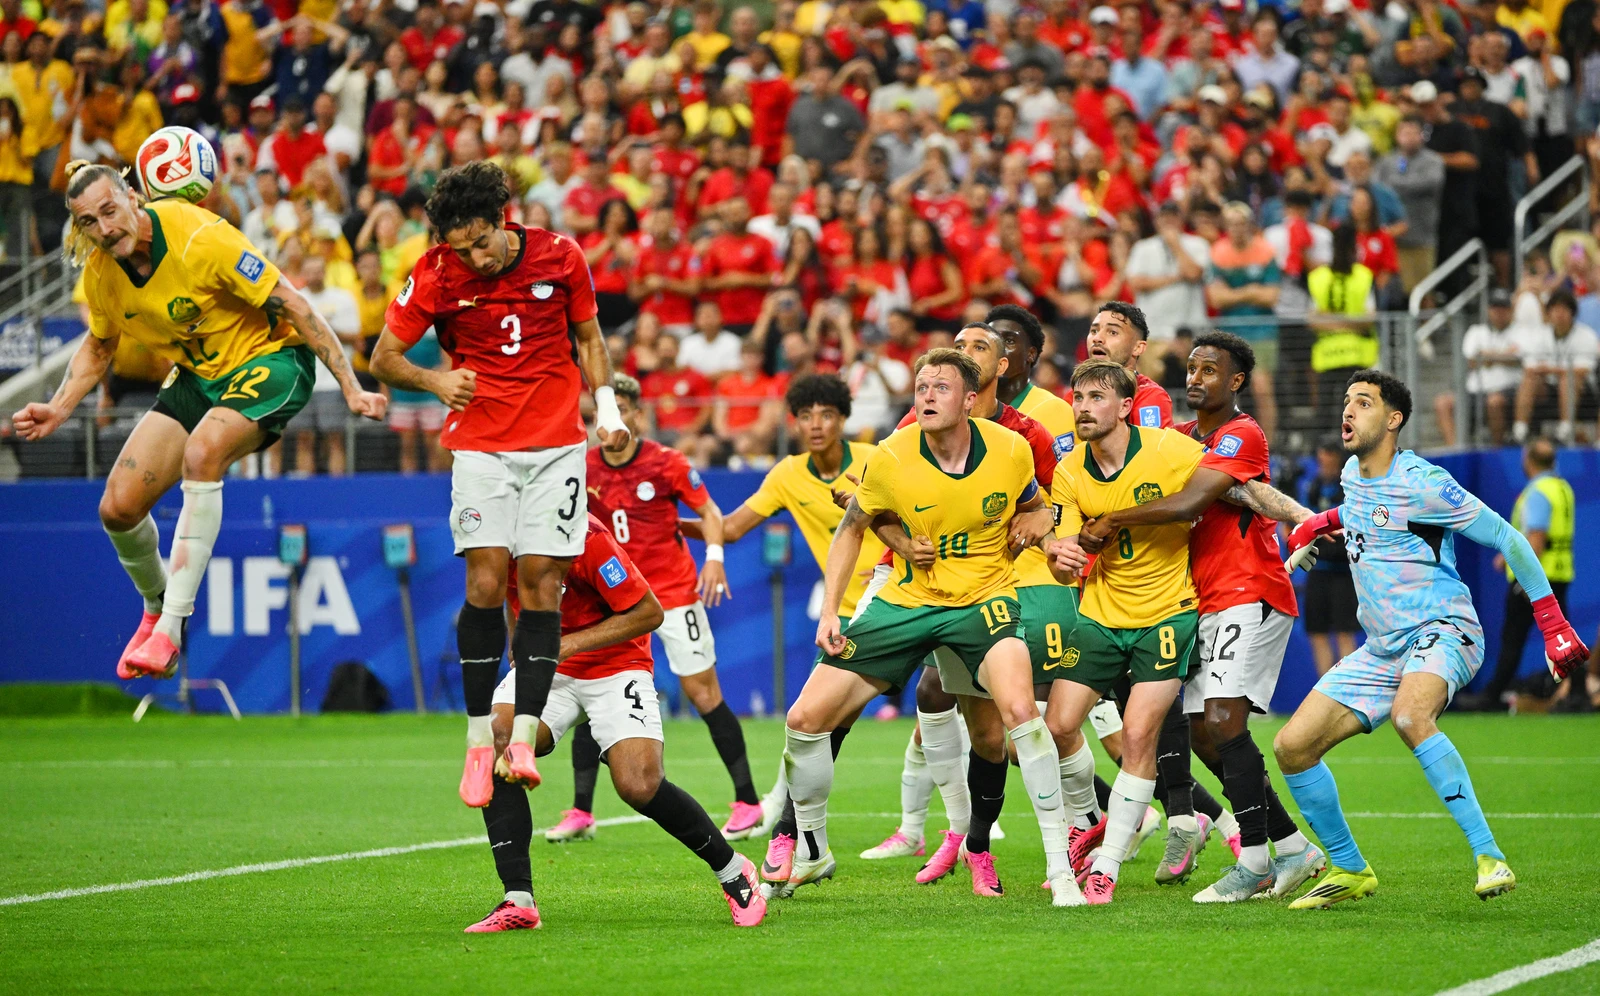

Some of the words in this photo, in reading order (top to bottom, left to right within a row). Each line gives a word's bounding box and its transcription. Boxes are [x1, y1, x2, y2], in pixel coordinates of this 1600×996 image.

[500, 315, 522, 356] 3
[226, 366, 271, 399] 22
[558, 477, 580, 521] 3
[612, 510, 631, 544] 8
[1118, 528, 1134, 559] 8
[938, 532, 969, 560] 19
[163, 556, 362, 637] IFA
[684, 610, 700, 641] 8
[980, 600, 1011, 629] 19
[1045, 623, 1063, 658] 9
[1158, 625, 1177, 659] 8
[1208, 623, 1242, 663] 12
[624, 680, 644, 710] 4
